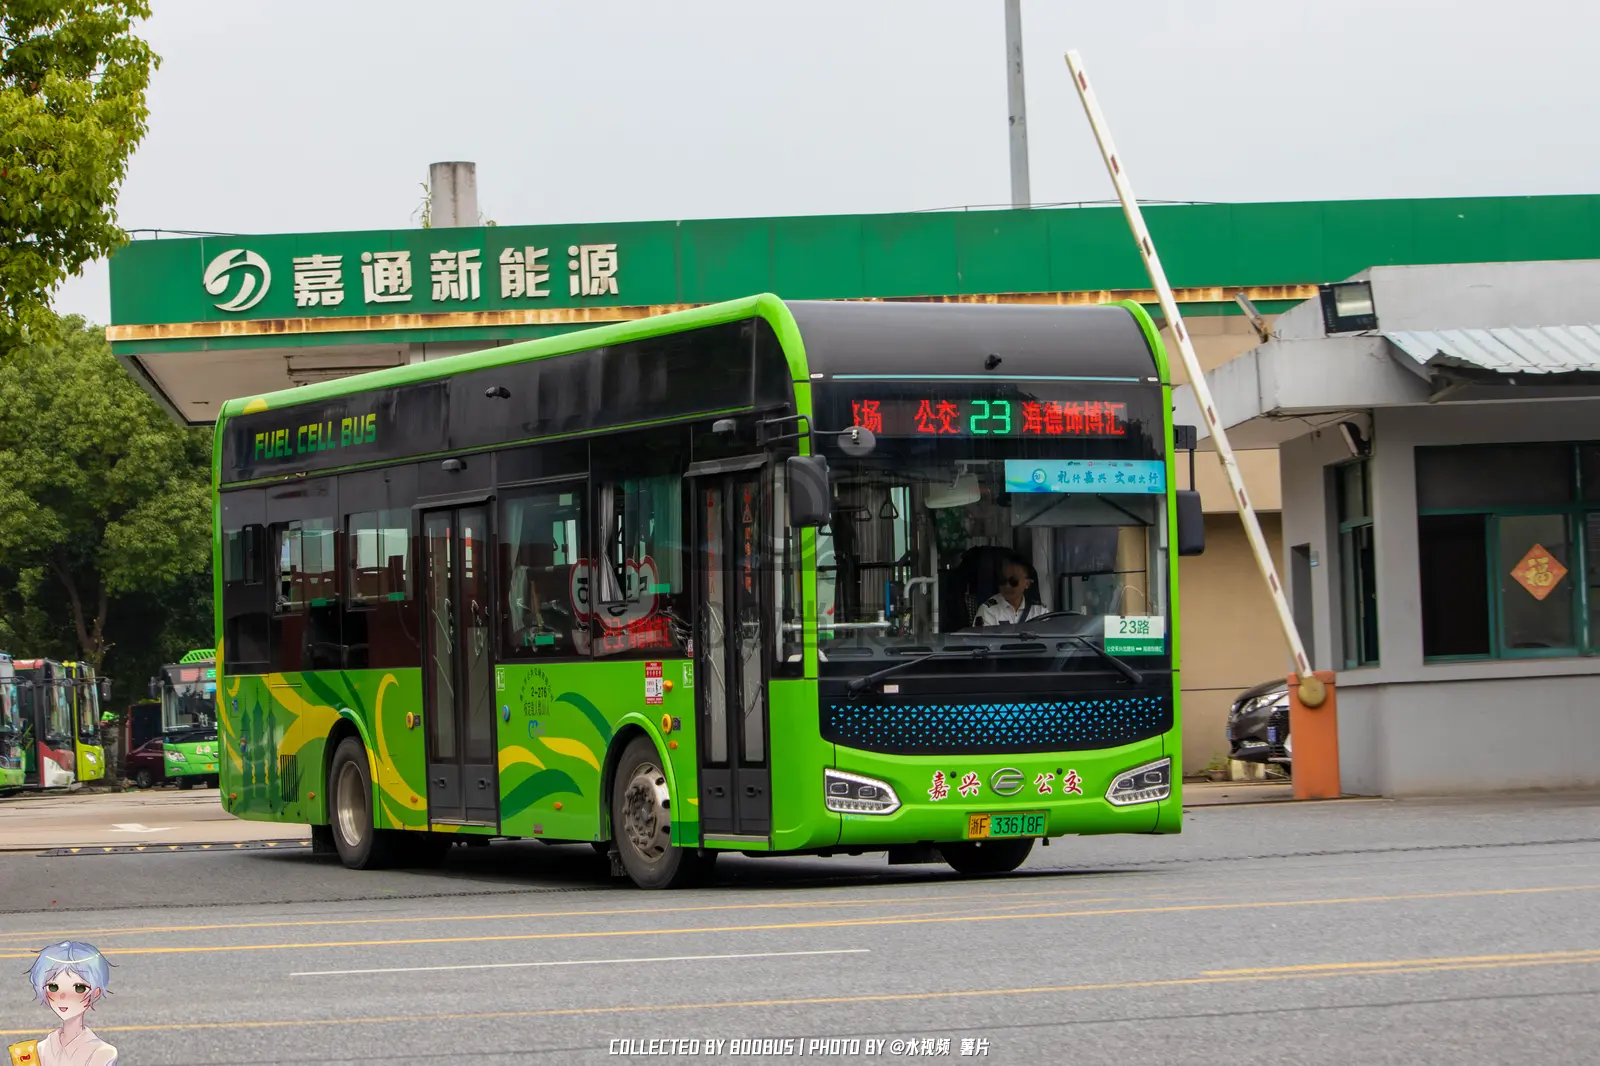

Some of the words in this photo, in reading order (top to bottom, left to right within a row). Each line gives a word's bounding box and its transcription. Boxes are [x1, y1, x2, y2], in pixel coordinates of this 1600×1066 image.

[293, 243, 619, 307] 嘉通新能源
[914, 399, 960, 433] 公交
[970, 400, 1011, 434] 23
[255, 428, 292, 460] FUEL
[297, 421, 336, 454] CELL
[341, 413, 376, 447] BUS
[1119, 620, 1150, 635] 23路
[928, 769, 982, 801] 嘉兴
[1034, 769, 1083, 796] 公交
[970, 817, 988, 835] 浙F
[994, 815, 1044, 835] 33618F
